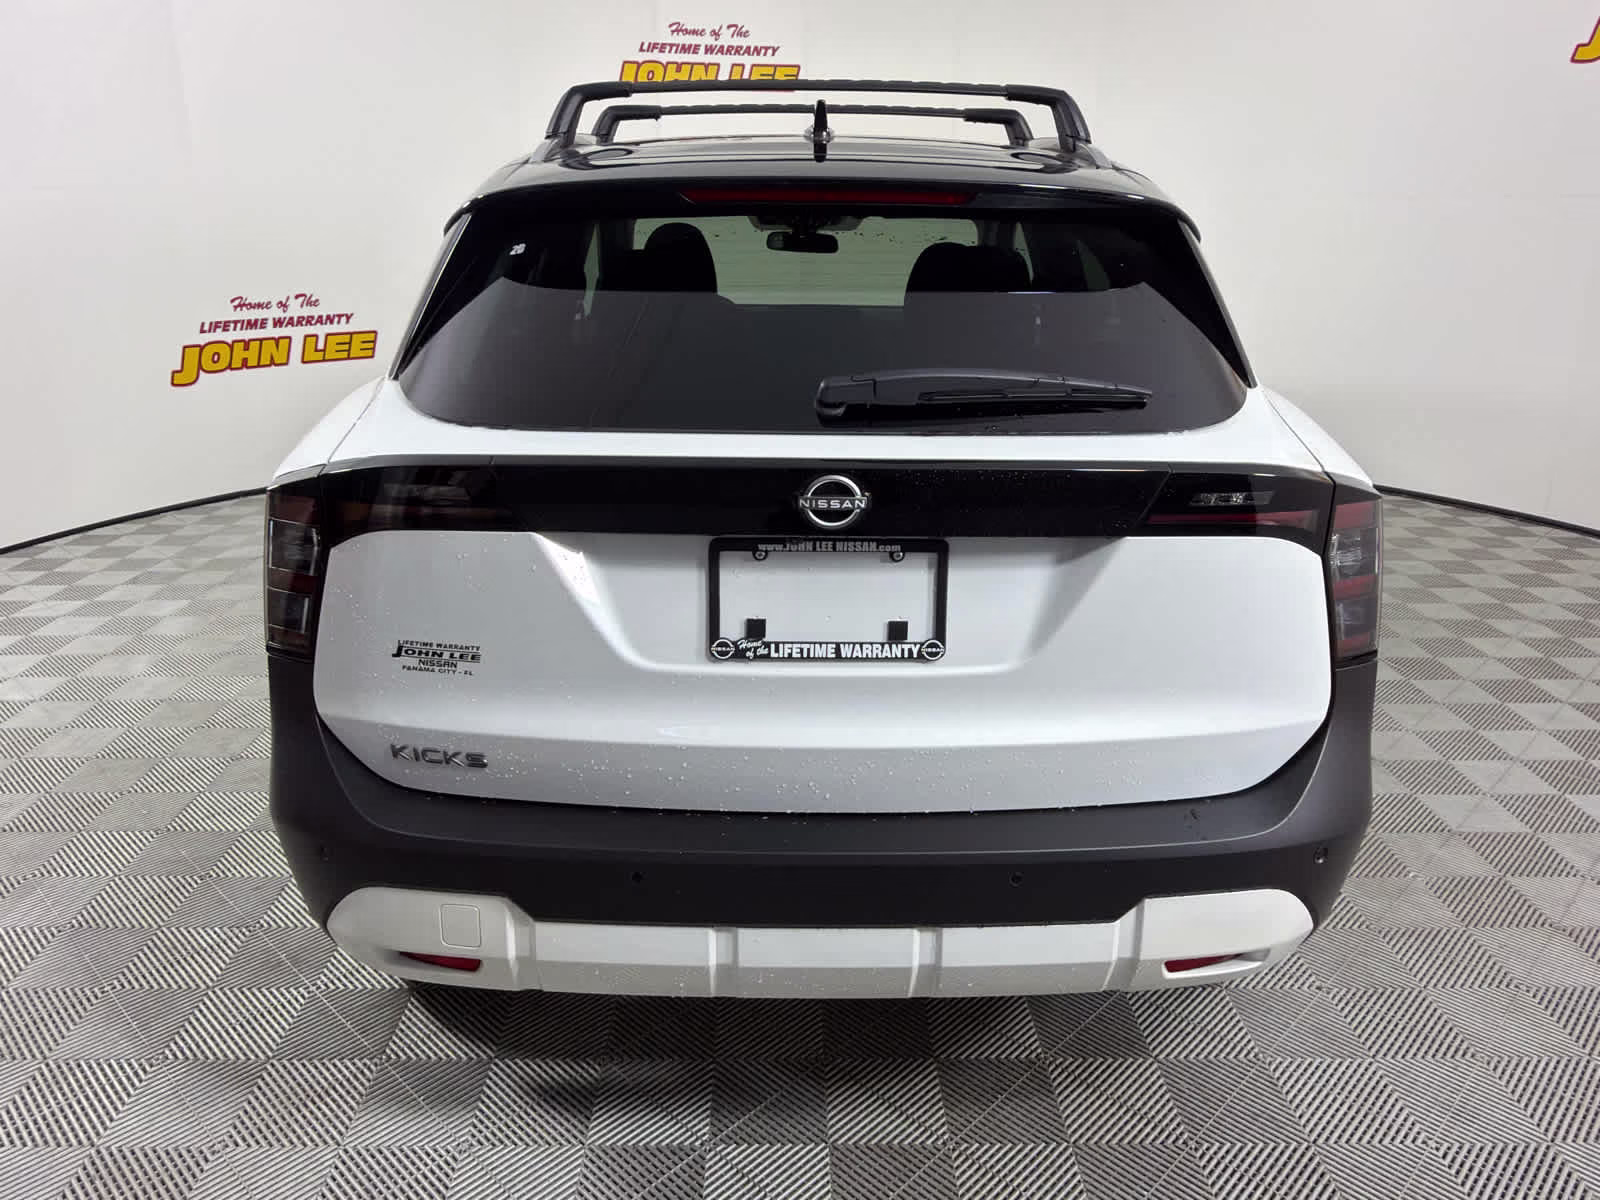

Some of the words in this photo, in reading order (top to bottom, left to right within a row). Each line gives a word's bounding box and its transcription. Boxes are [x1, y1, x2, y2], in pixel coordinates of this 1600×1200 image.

[668, 21, 706, 37] Home
[709, 24, 723, 41] of
[726, 23, 750, 39] The
[638, 41, 701, 55] LIFETIME
[704, 44, 780, 57] WARRANTY
[230, 295, 272, 312] Home
[276, 295, 290, 313] of
[294, 293, 320, 309] The
[199, 317, 268, 334] LIFETIME
[272, 313, 354, 329] WARRANTY
[171, 335, 292, 387] JOHN
[301, 330, 378, 364] LEE
[800, 498, 866, 509] NISSAN
[815, 541, 833, 552] LEE
[398, 639, 434, 648] LIFETIME
[436, 643, 480, 652] WARRANTY
[737, 639, 762, 650] Home
[770, 643, 838, 658] LIFETIME
[840, 643, 921, 659] WARRANTY
[392, 645, 444, 658] JOHN
[449, 652, 481, 661] LEE
[745, 647, 755, 659] of
[418, 659, 458, 669] NISSAN
[390, 743, 489, 769] KICKS
